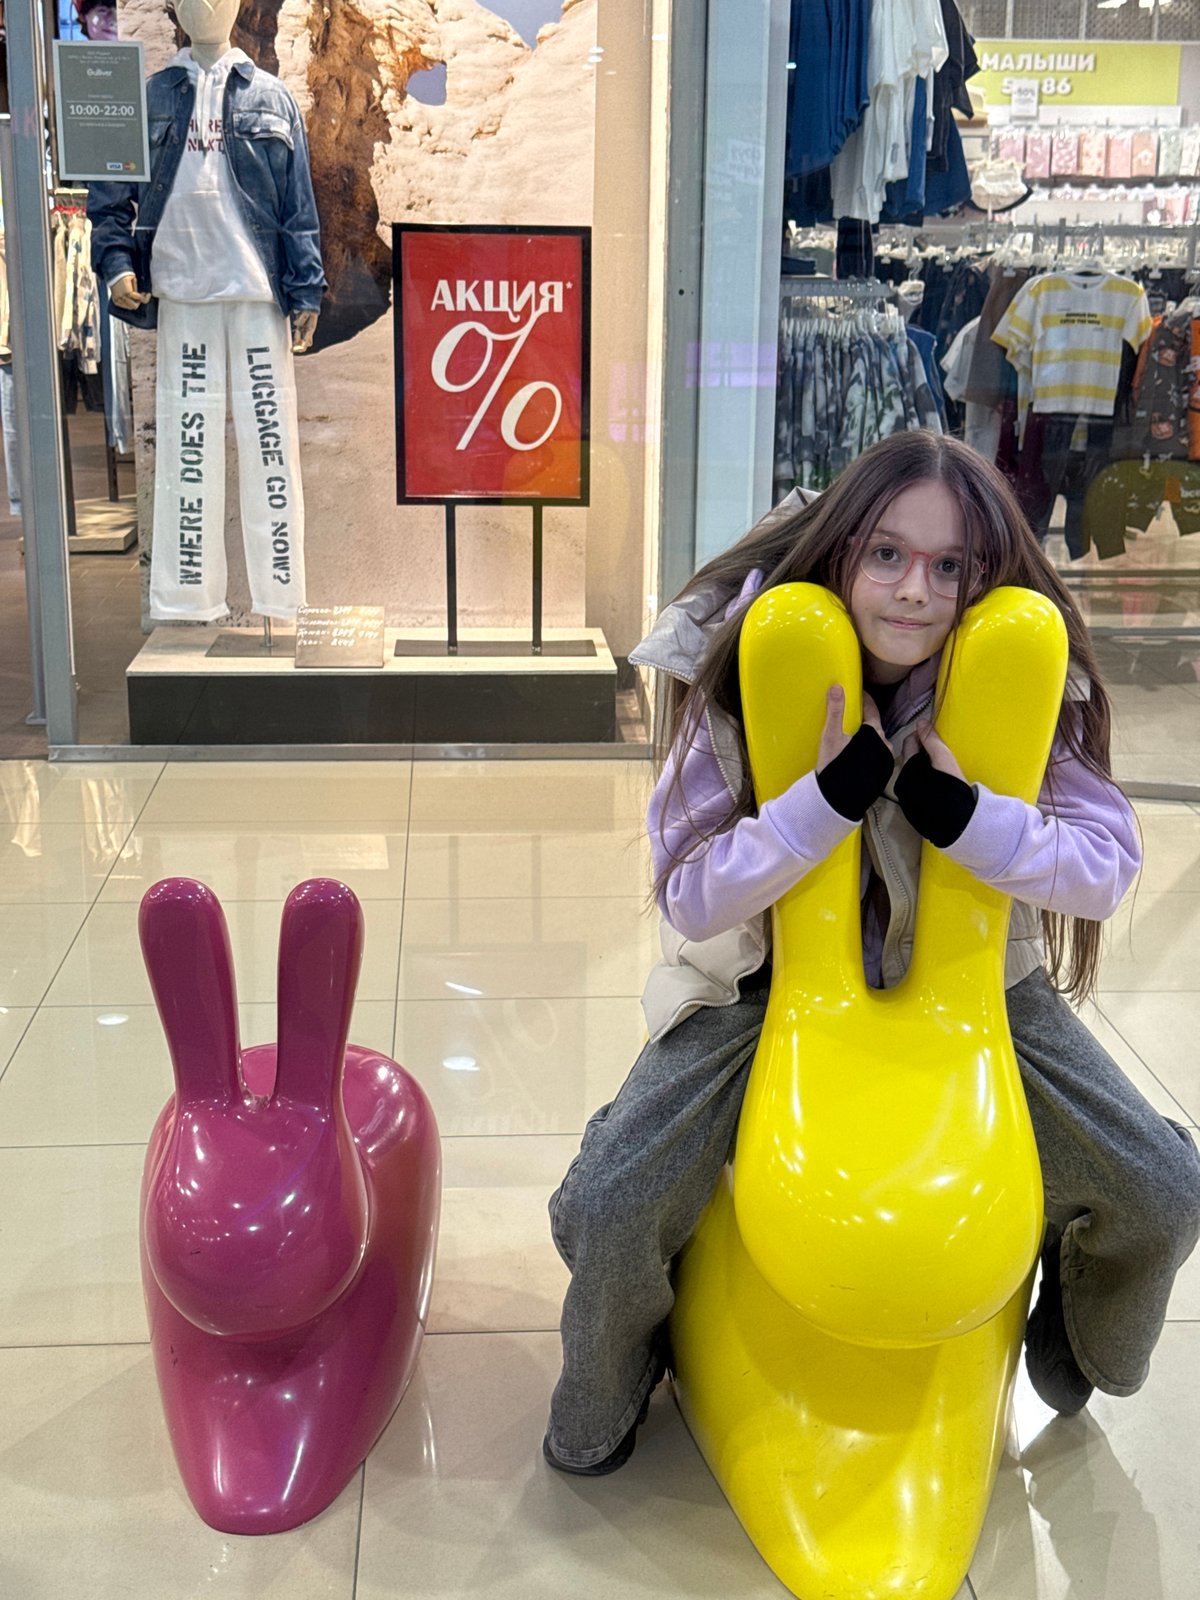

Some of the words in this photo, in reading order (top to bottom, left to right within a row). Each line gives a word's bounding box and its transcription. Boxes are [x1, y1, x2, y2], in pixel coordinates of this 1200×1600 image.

[981, 52, 1096, 73] МАЛЫШИ
[69, 104, 135, 116] 10:00-22:00
[181, 342, 207, 398] THE
[246, 346, 284, 467] LUGGAGE
[179, 411, 205, 485] DOES
[265, 475, 288, 510] GO
[178, 496, 204, 586] WHERE
[271, 520, 291, 586] NOW?
